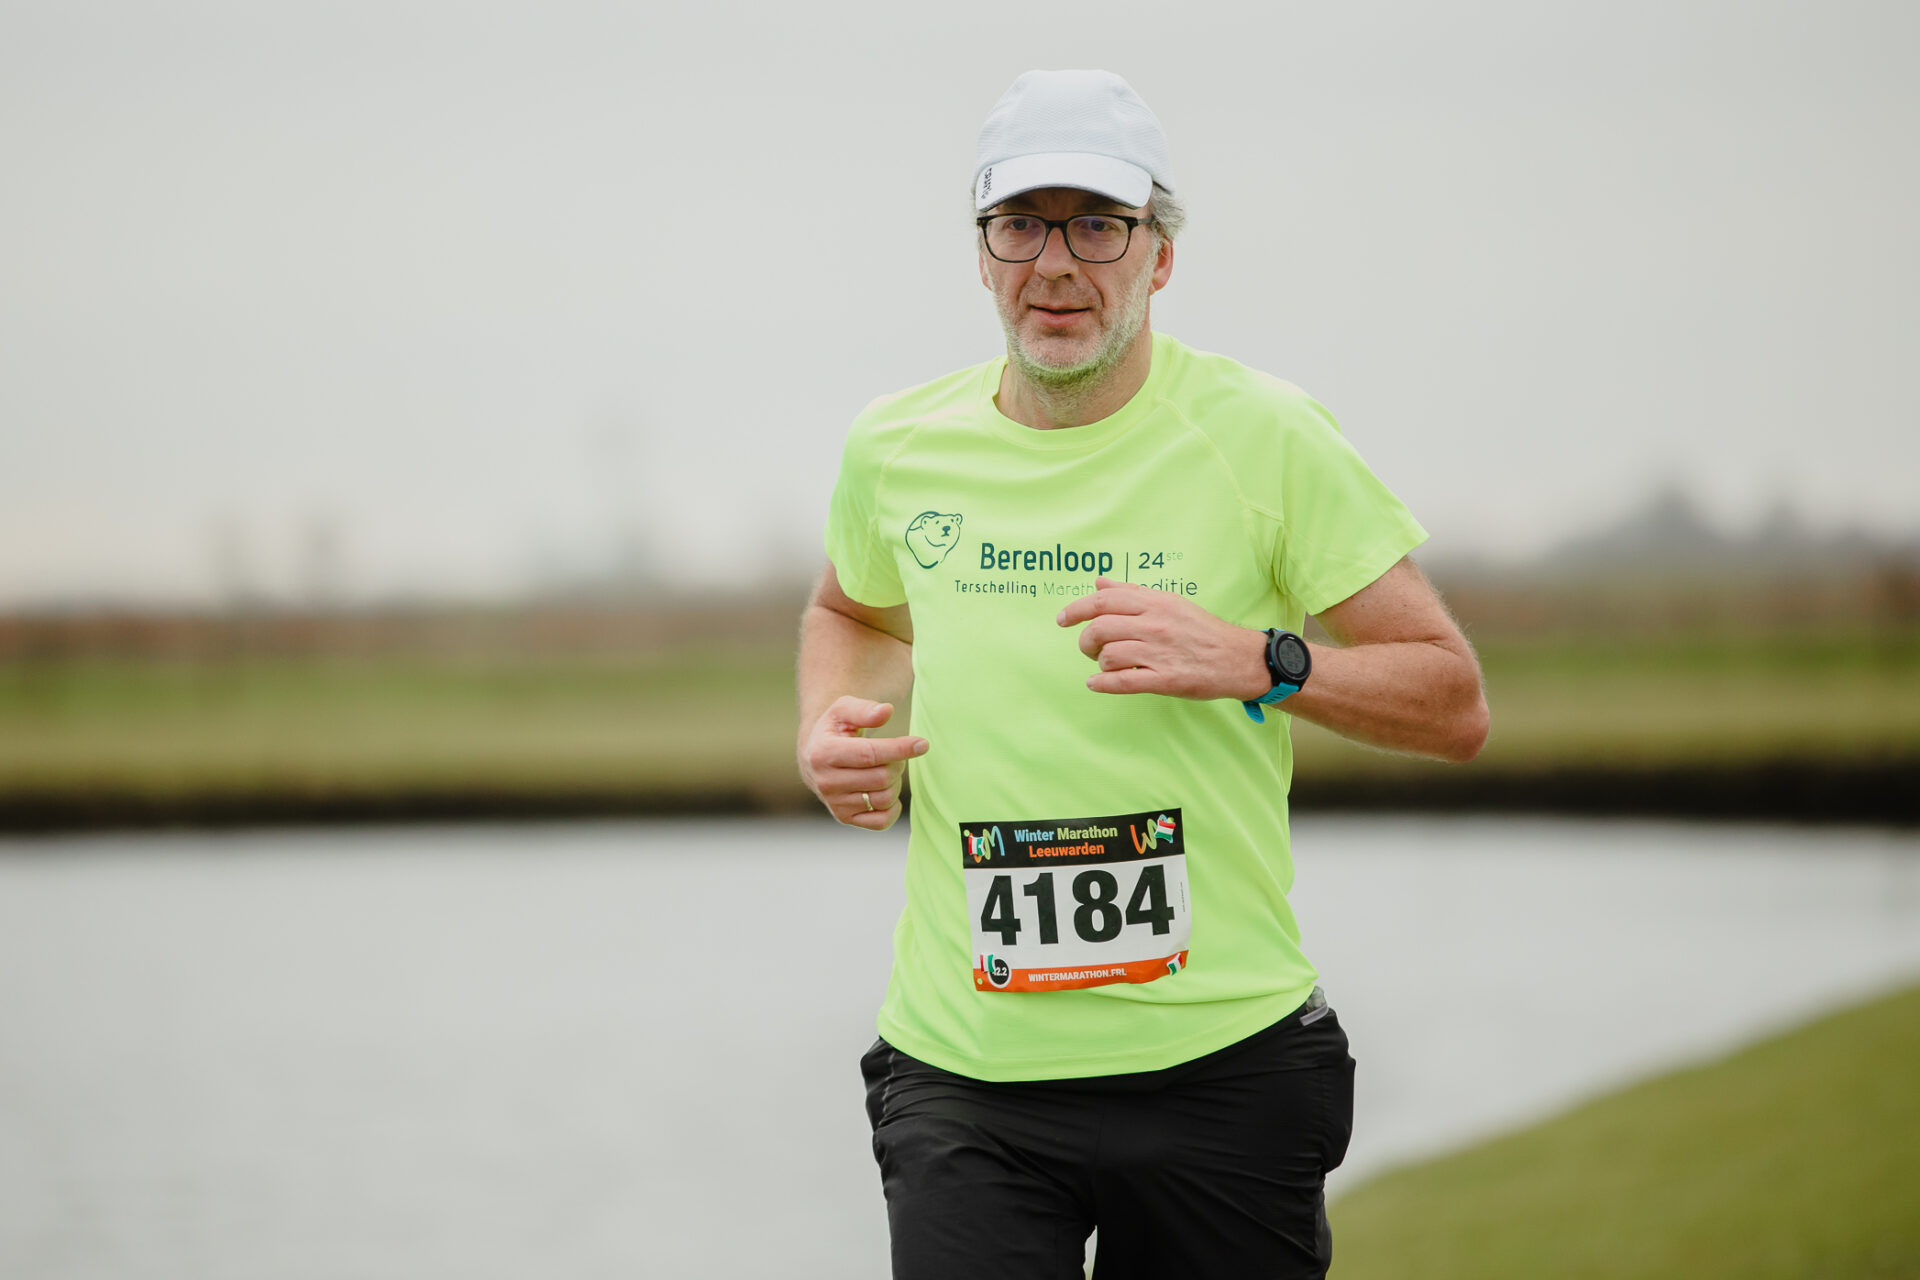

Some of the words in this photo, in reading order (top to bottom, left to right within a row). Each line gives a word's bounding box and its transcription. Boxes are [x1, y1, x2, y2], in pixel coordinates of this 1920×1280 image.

[980, 542, 1113, 576] Berenloop
[954, 579, 1037, 598] Terschelling
[1043, 581, 1096, 596] Marath
[1014, 829, 1055, 843] Winter
[1057, 826, 1118, 841] Marathon
[1028, 842, 1105, 858] Leeuwarden
[980, 864, 1175, 946] 4184
[992, 966, 1008, 976] 2.2
[1028, 968, 1127, 982] WINTERMARATHON.FRL
